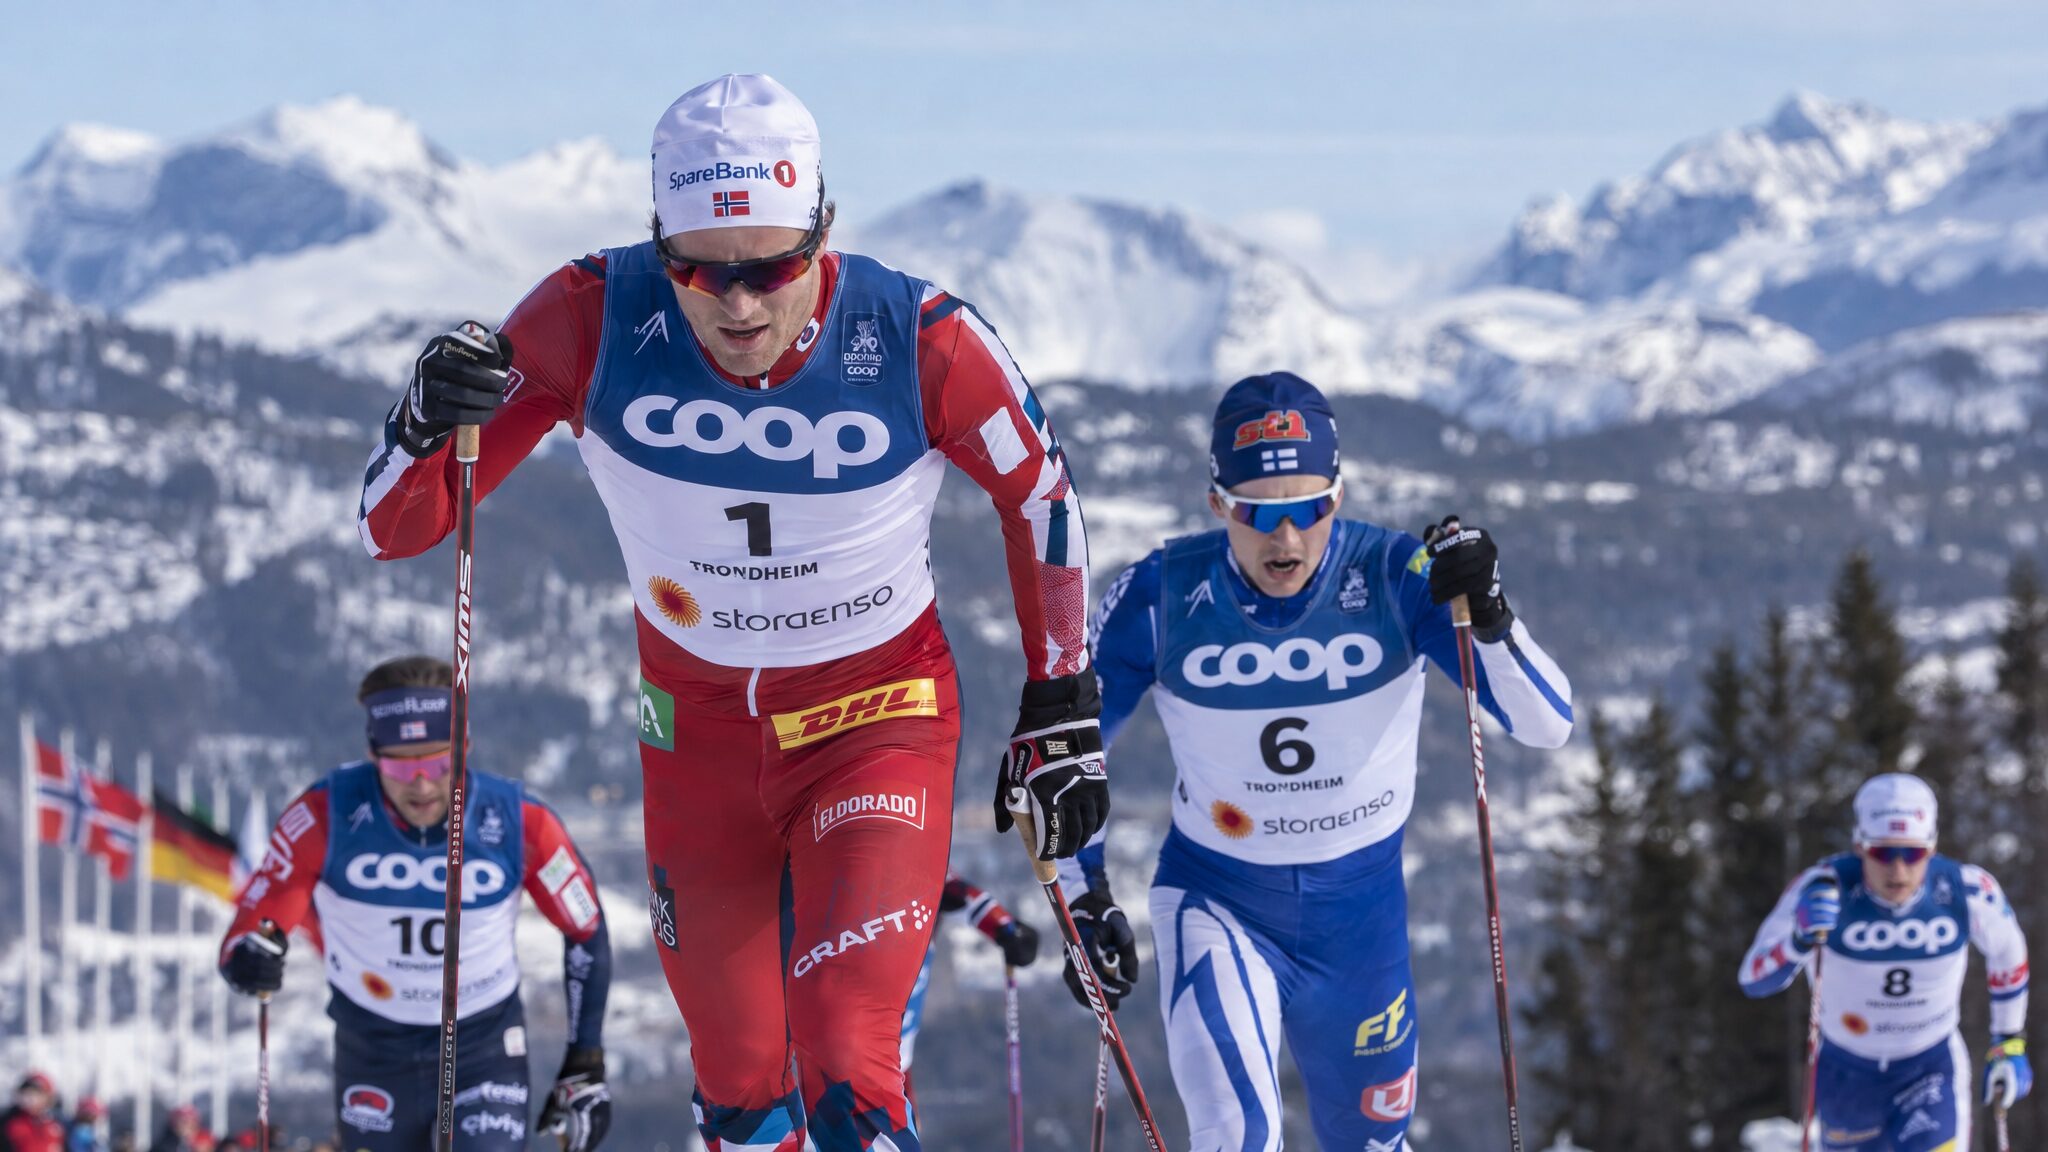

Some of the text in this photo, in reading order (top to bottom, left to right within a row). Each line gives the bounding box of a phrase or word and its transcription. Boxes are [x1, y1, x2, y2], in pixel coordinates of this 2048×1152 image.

[669, 162, 771, 191] SpareBank
[622, 394, 891, 479] coop
[724, 502, 772, 557] 1
[690, 561, 819, 580] TRONDHEIM
[712, 585, 893, 631] storaenso
[1182, 633, 1383, 690] coop
[800, 686, 922, 738] DHL
[1259, 717, 1315, 775] 6
[1243, 776, 1344, 793] TRONDHEIM
[820, 793, 917, 832] ELDORADO
[1263, 790, 1394, 835] storaenso
[345, 852, 506, 903] coop
[390, 916, 446, 956] 10
[793, 910, 907, 978] CRAFT
[1841, 916, 1959, 955] coop
[1882, 966, 1912, 998] 8
